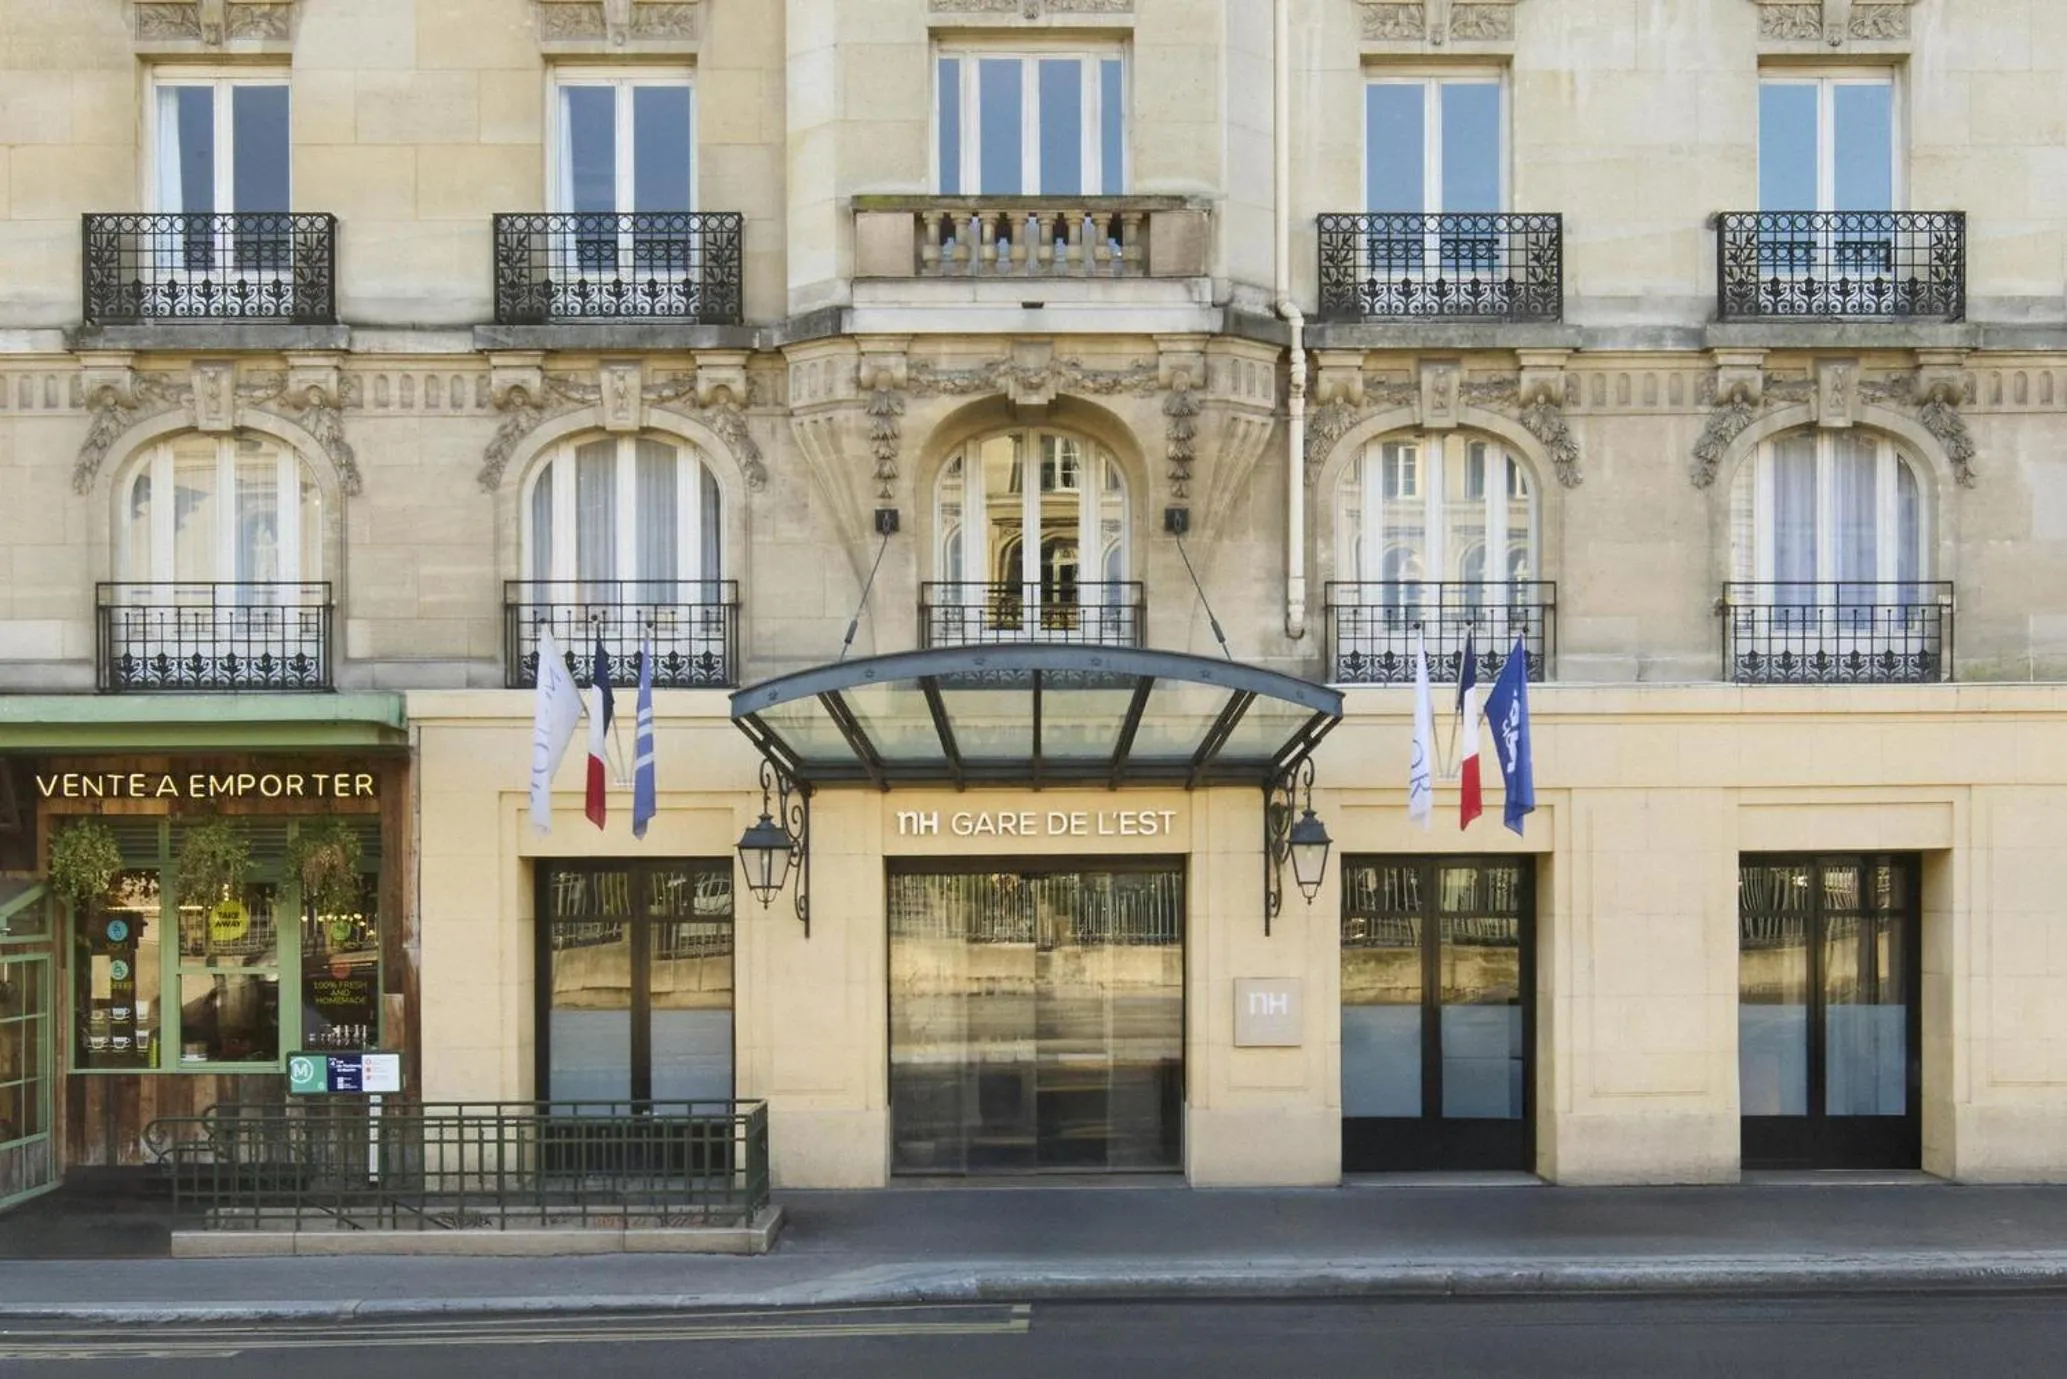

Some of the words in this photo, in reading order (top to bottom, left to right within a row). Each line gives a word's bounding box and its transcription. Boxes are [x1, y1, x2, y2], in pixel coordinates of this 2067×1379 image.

[36, 773, 145, 798] VENTE
[155, 774, 179, 798] A
[951, 811, 1037, 836] GARE
[1048, 811, 1088, 835] DE
[1098, 810, 1177, 835] L'EST
[217, 911, 240, 919] TAKE
[215, 920, 241, 928] AWAY
[291, 1063, 309, 1077] M
